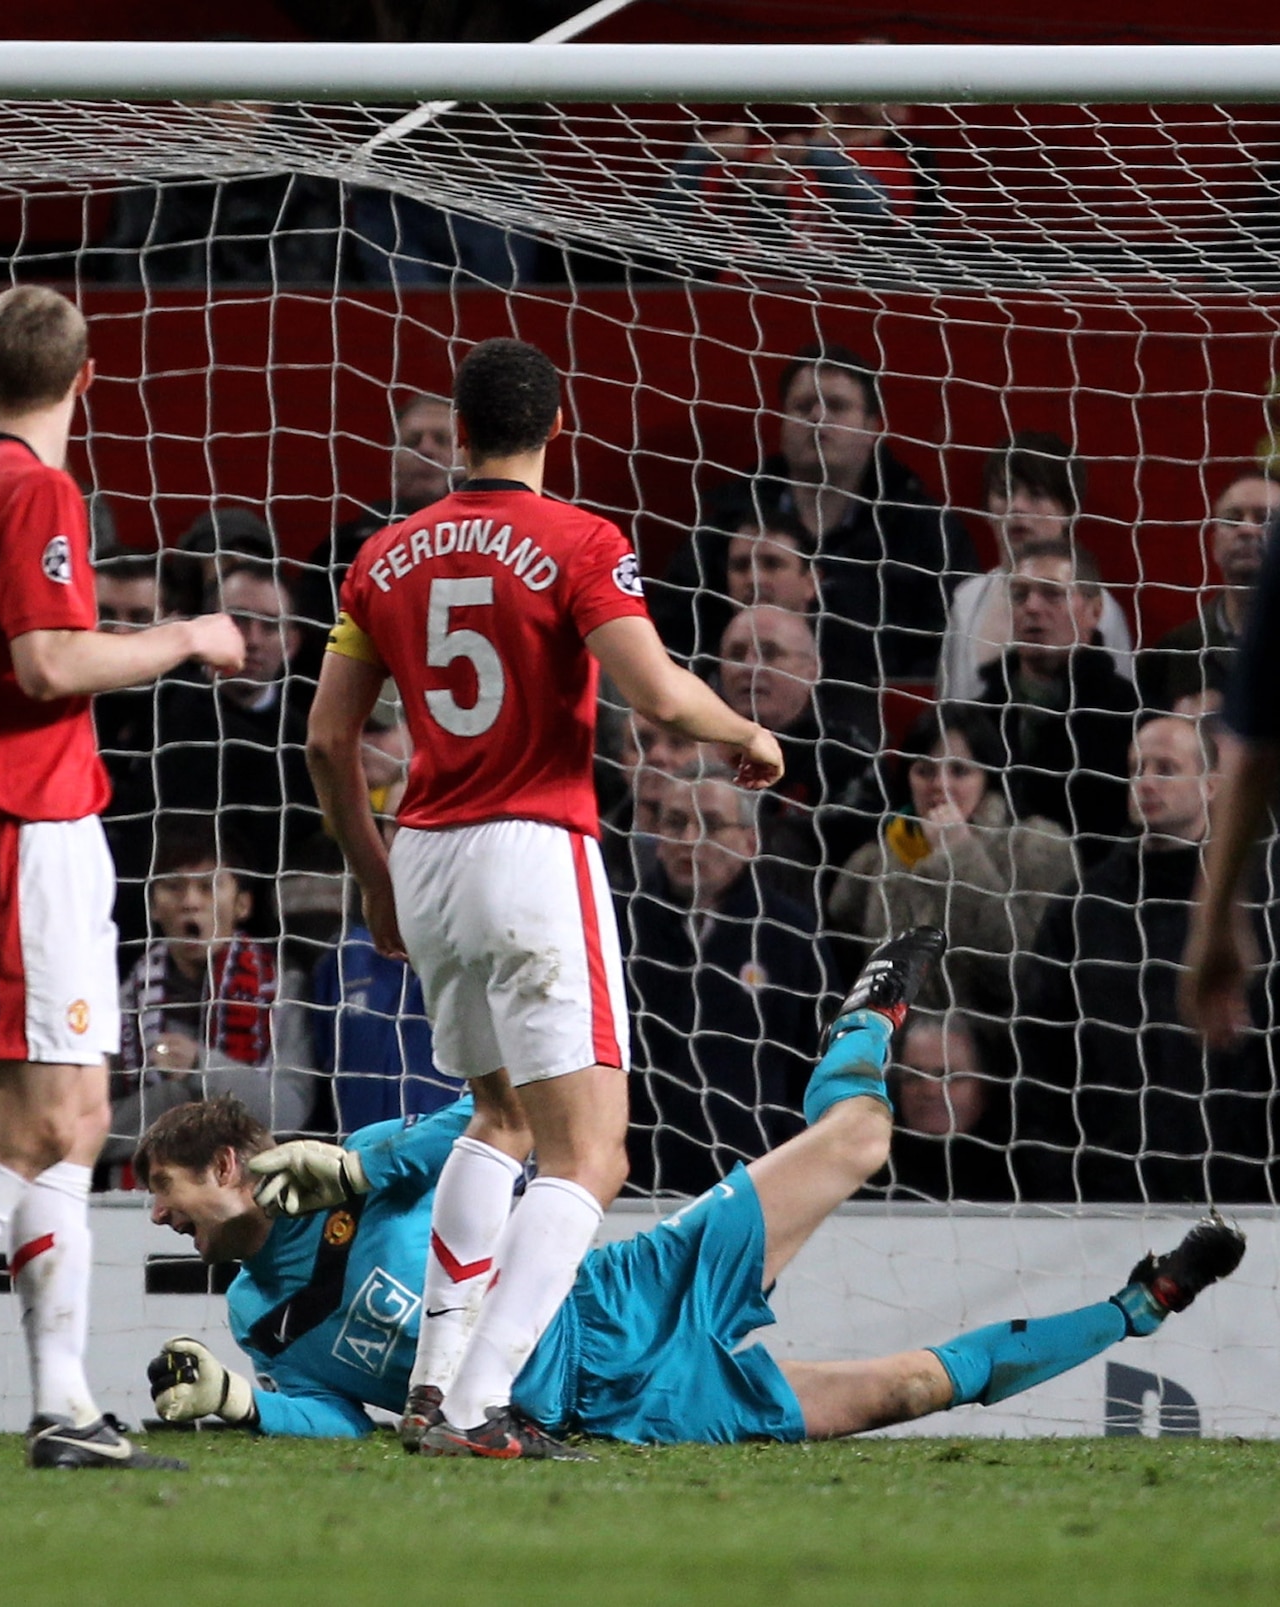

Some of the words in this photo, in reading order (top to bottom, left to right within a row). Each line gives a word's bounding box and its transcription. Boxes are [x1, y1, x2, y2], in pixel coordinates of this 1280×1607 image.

[368, 518, 558, 593] FERDINAND
[424, 576, 505, 737] 5
[343, 1279, 410, 1373] AIG
